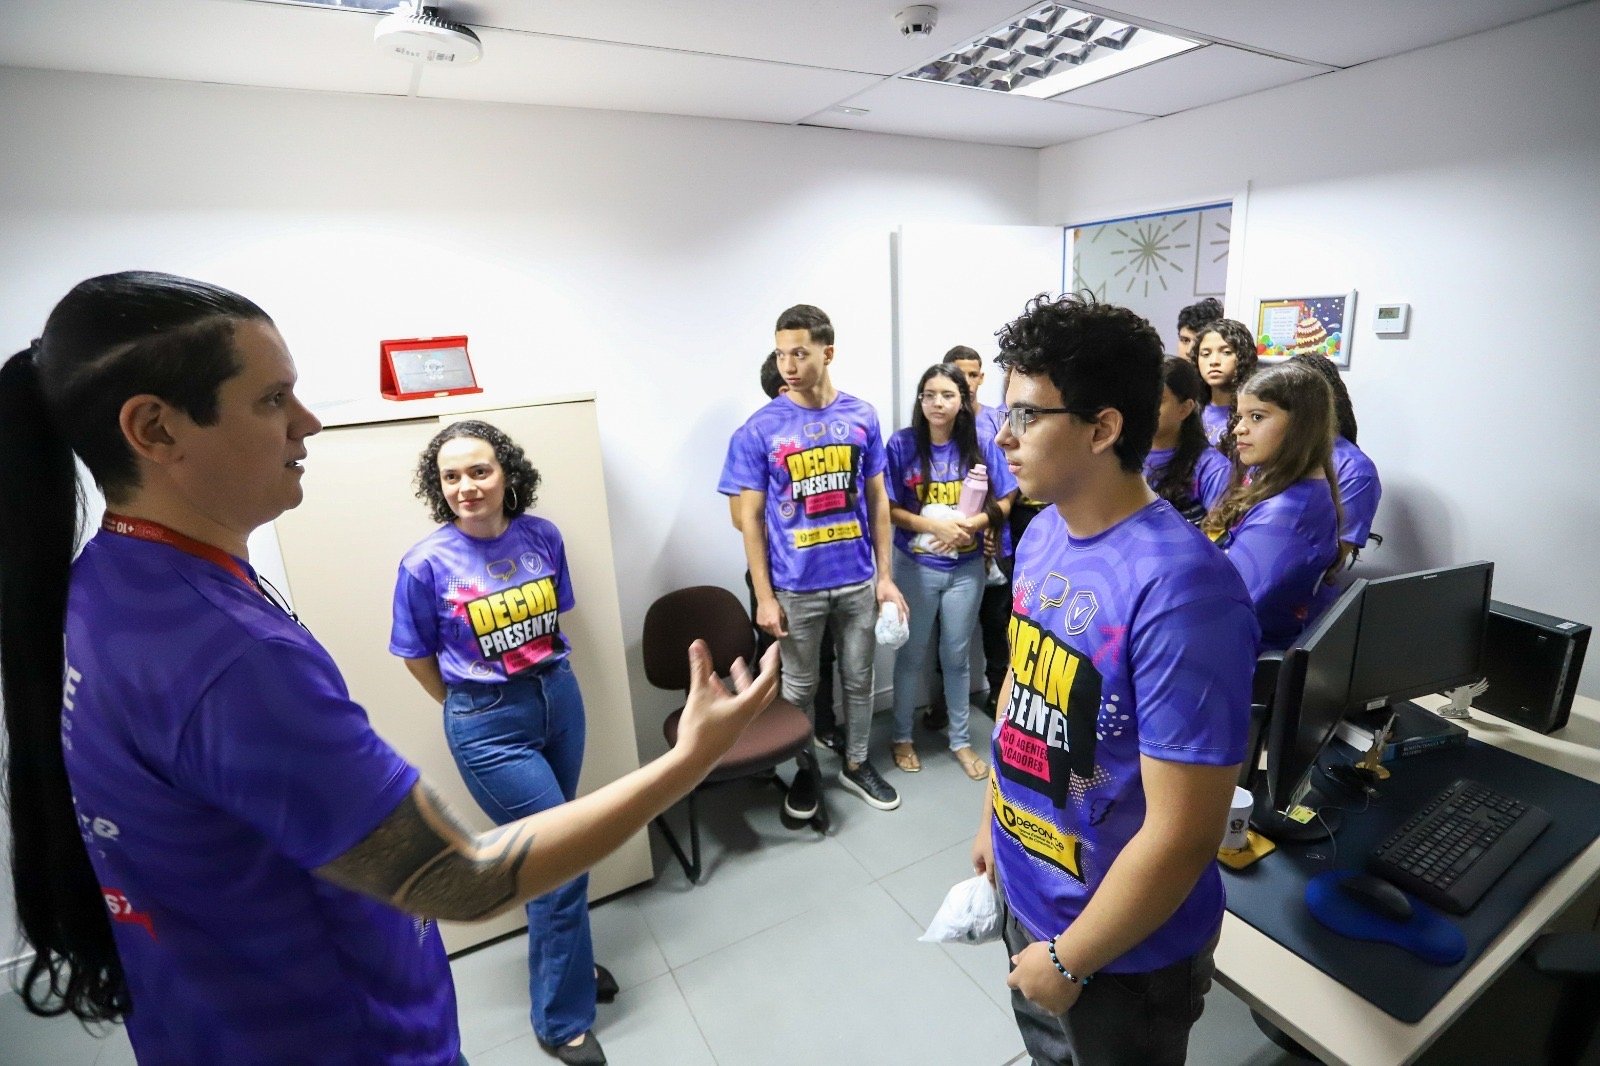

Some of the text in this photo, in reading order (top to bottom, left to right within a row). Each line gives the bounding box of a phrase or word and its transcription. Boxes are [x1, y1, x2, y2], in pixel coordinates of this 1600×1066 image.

[786, 445, 852, 482] DECON
[467, 577, 558, 636] DECON
[1016, 737, 1049, 761] AGENTES
